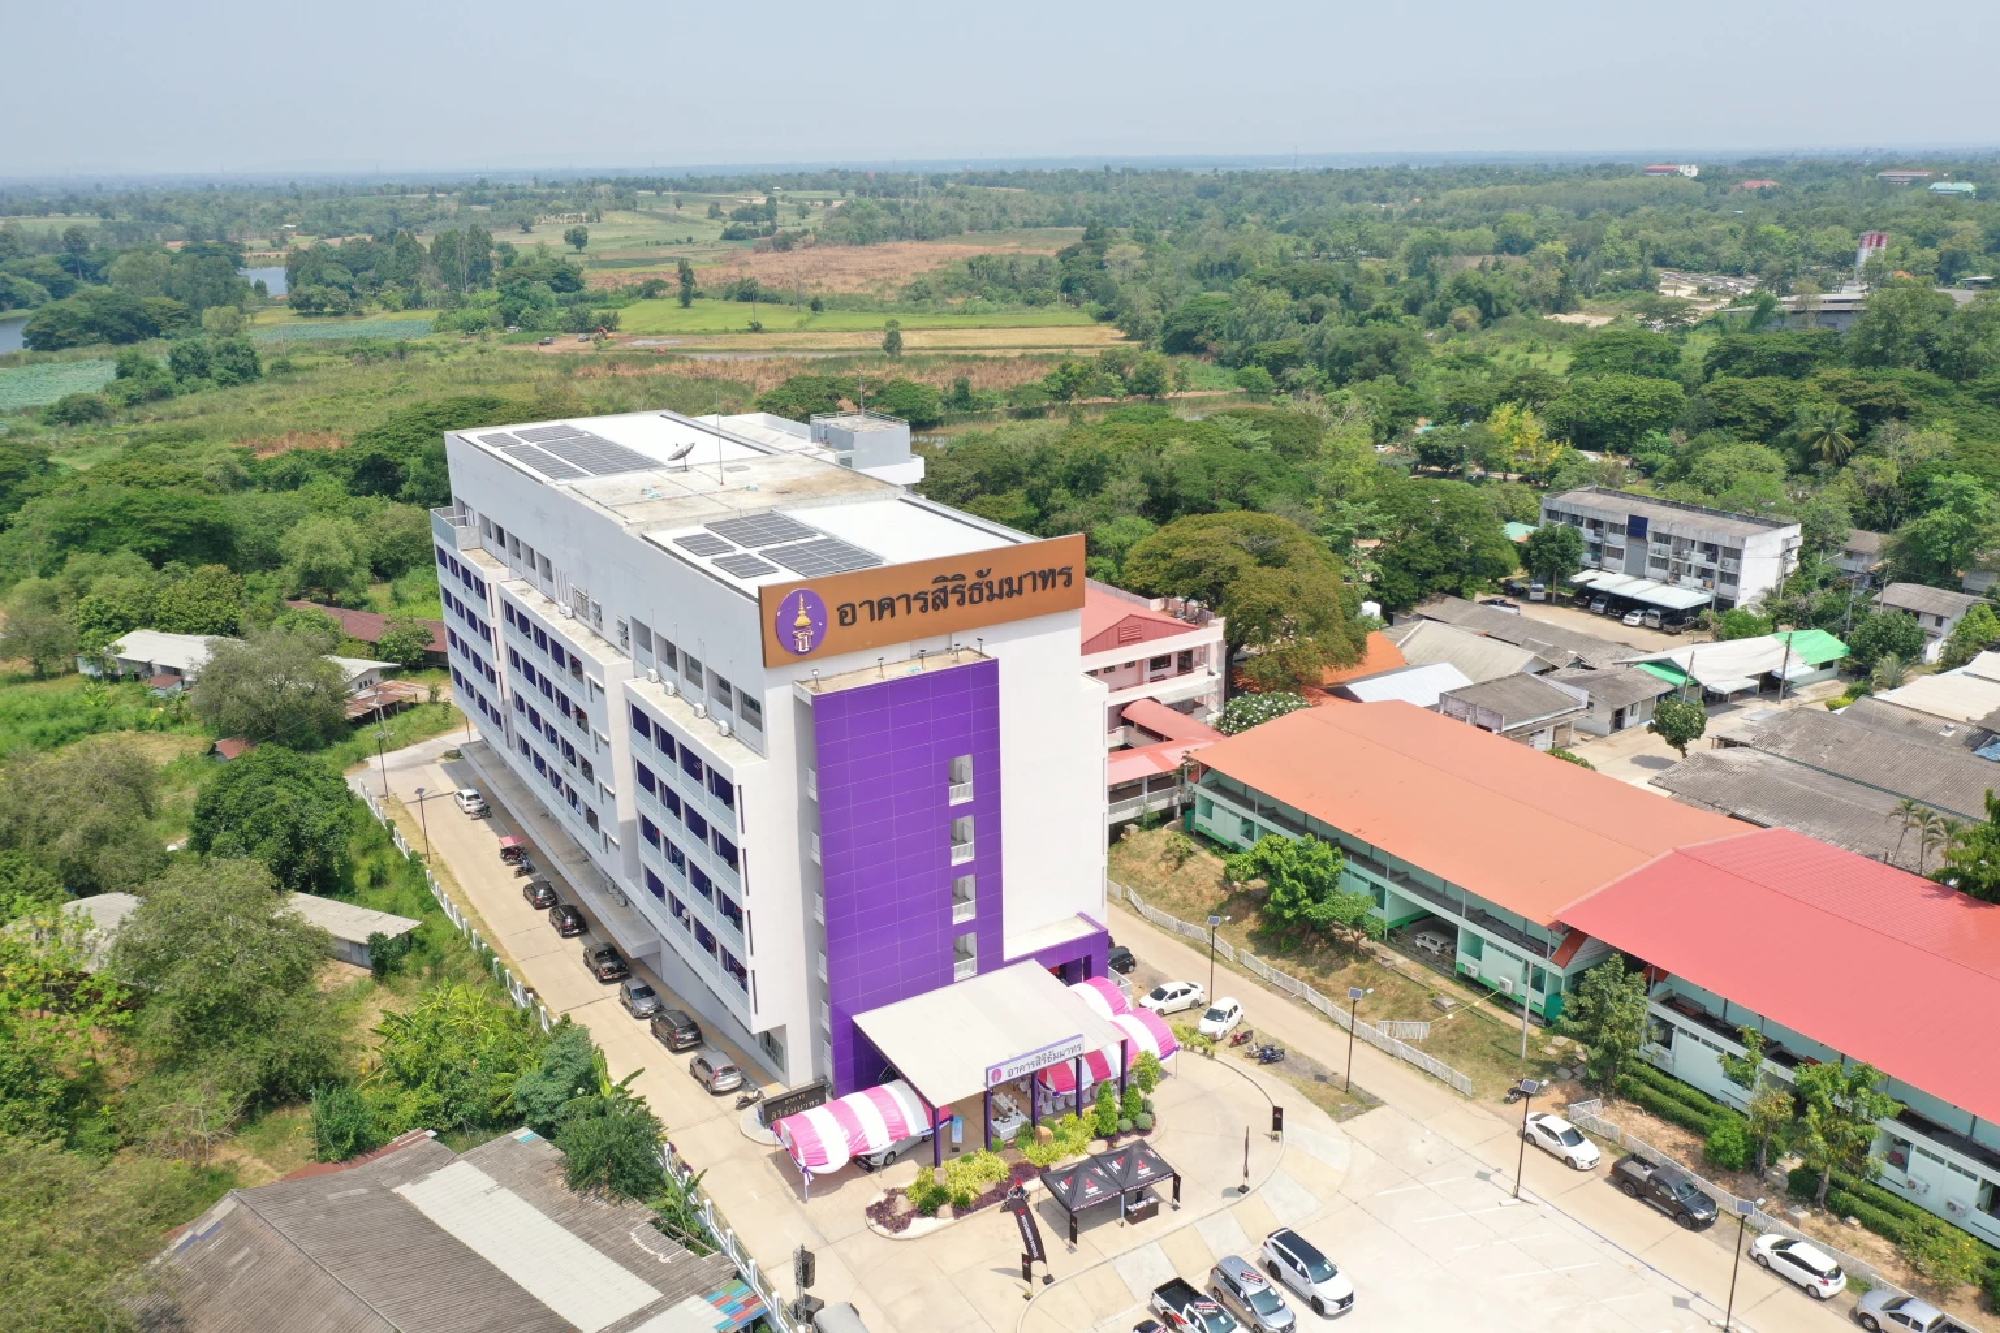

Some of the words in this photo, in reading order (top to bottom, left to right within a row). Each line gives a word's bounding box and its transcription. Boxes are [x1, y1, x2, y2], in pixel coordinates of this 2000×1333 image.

[837, 565, 1073, 627] อาคารสิริธัมมาทร
